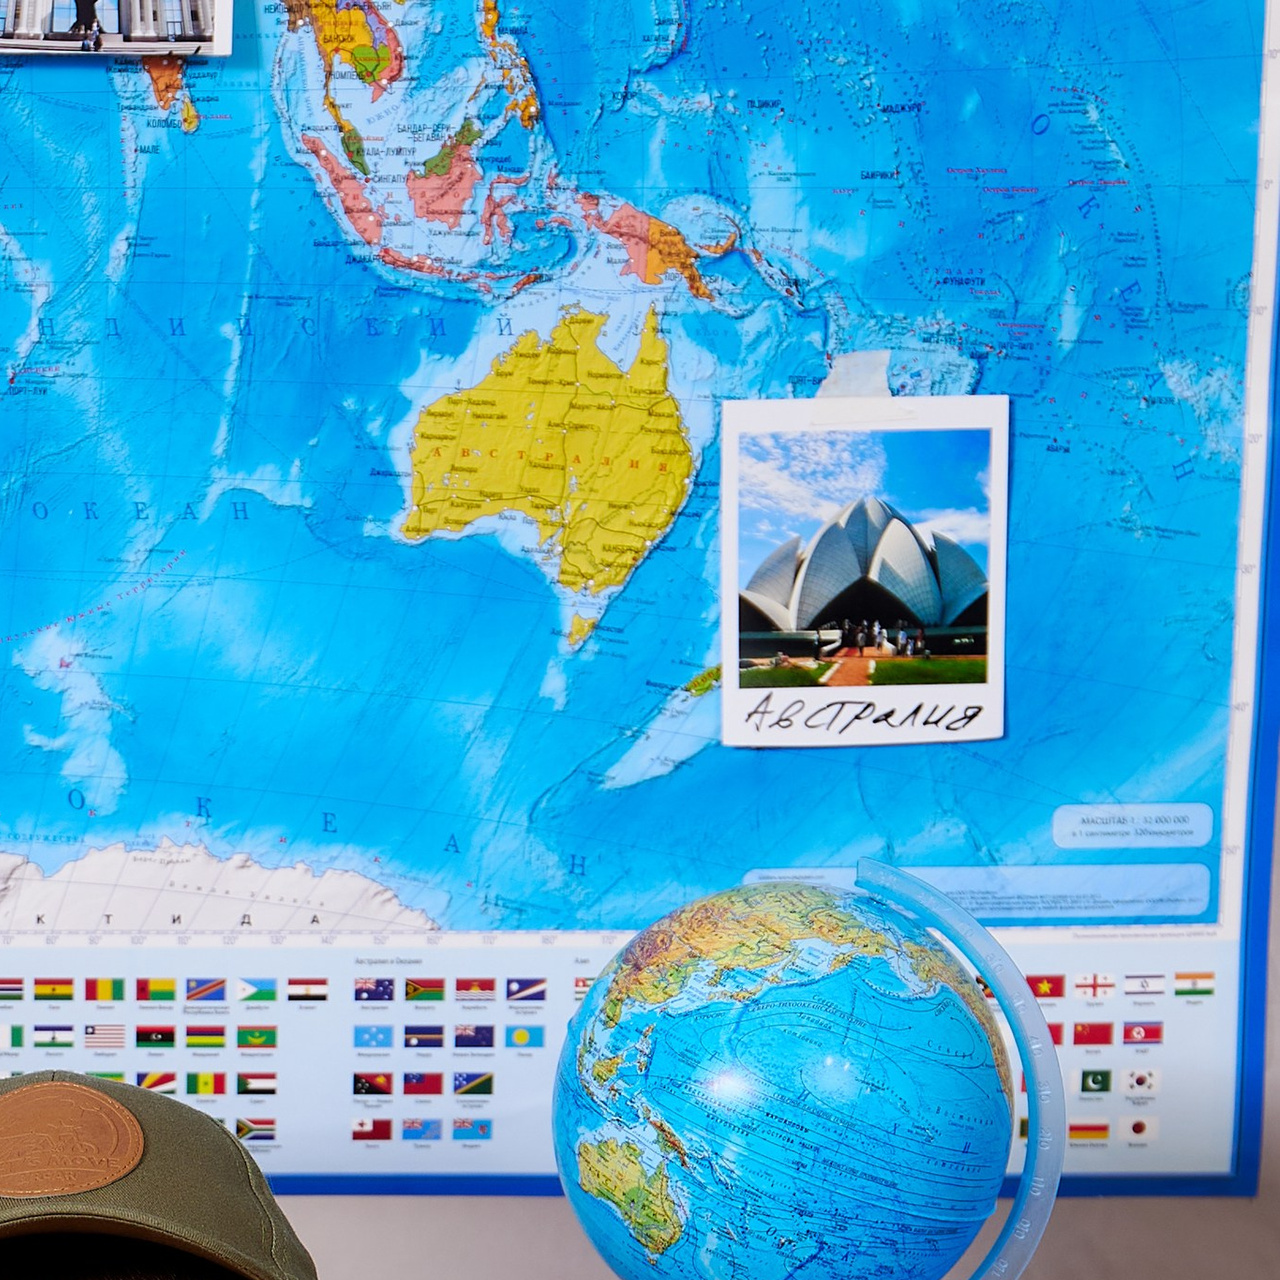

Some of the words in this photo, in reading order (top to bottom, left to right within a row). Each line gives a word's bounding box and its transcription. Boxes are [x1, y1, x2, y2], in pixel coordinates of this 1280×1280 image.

[140, 146, 159, 154] МАЛЕ
[943, 277, 986, 287] ФУНАФУТИ
[433, 448, 668, 472] АВСТРАЛИЯ
[48, 1156, 122, 1168] MOVE
